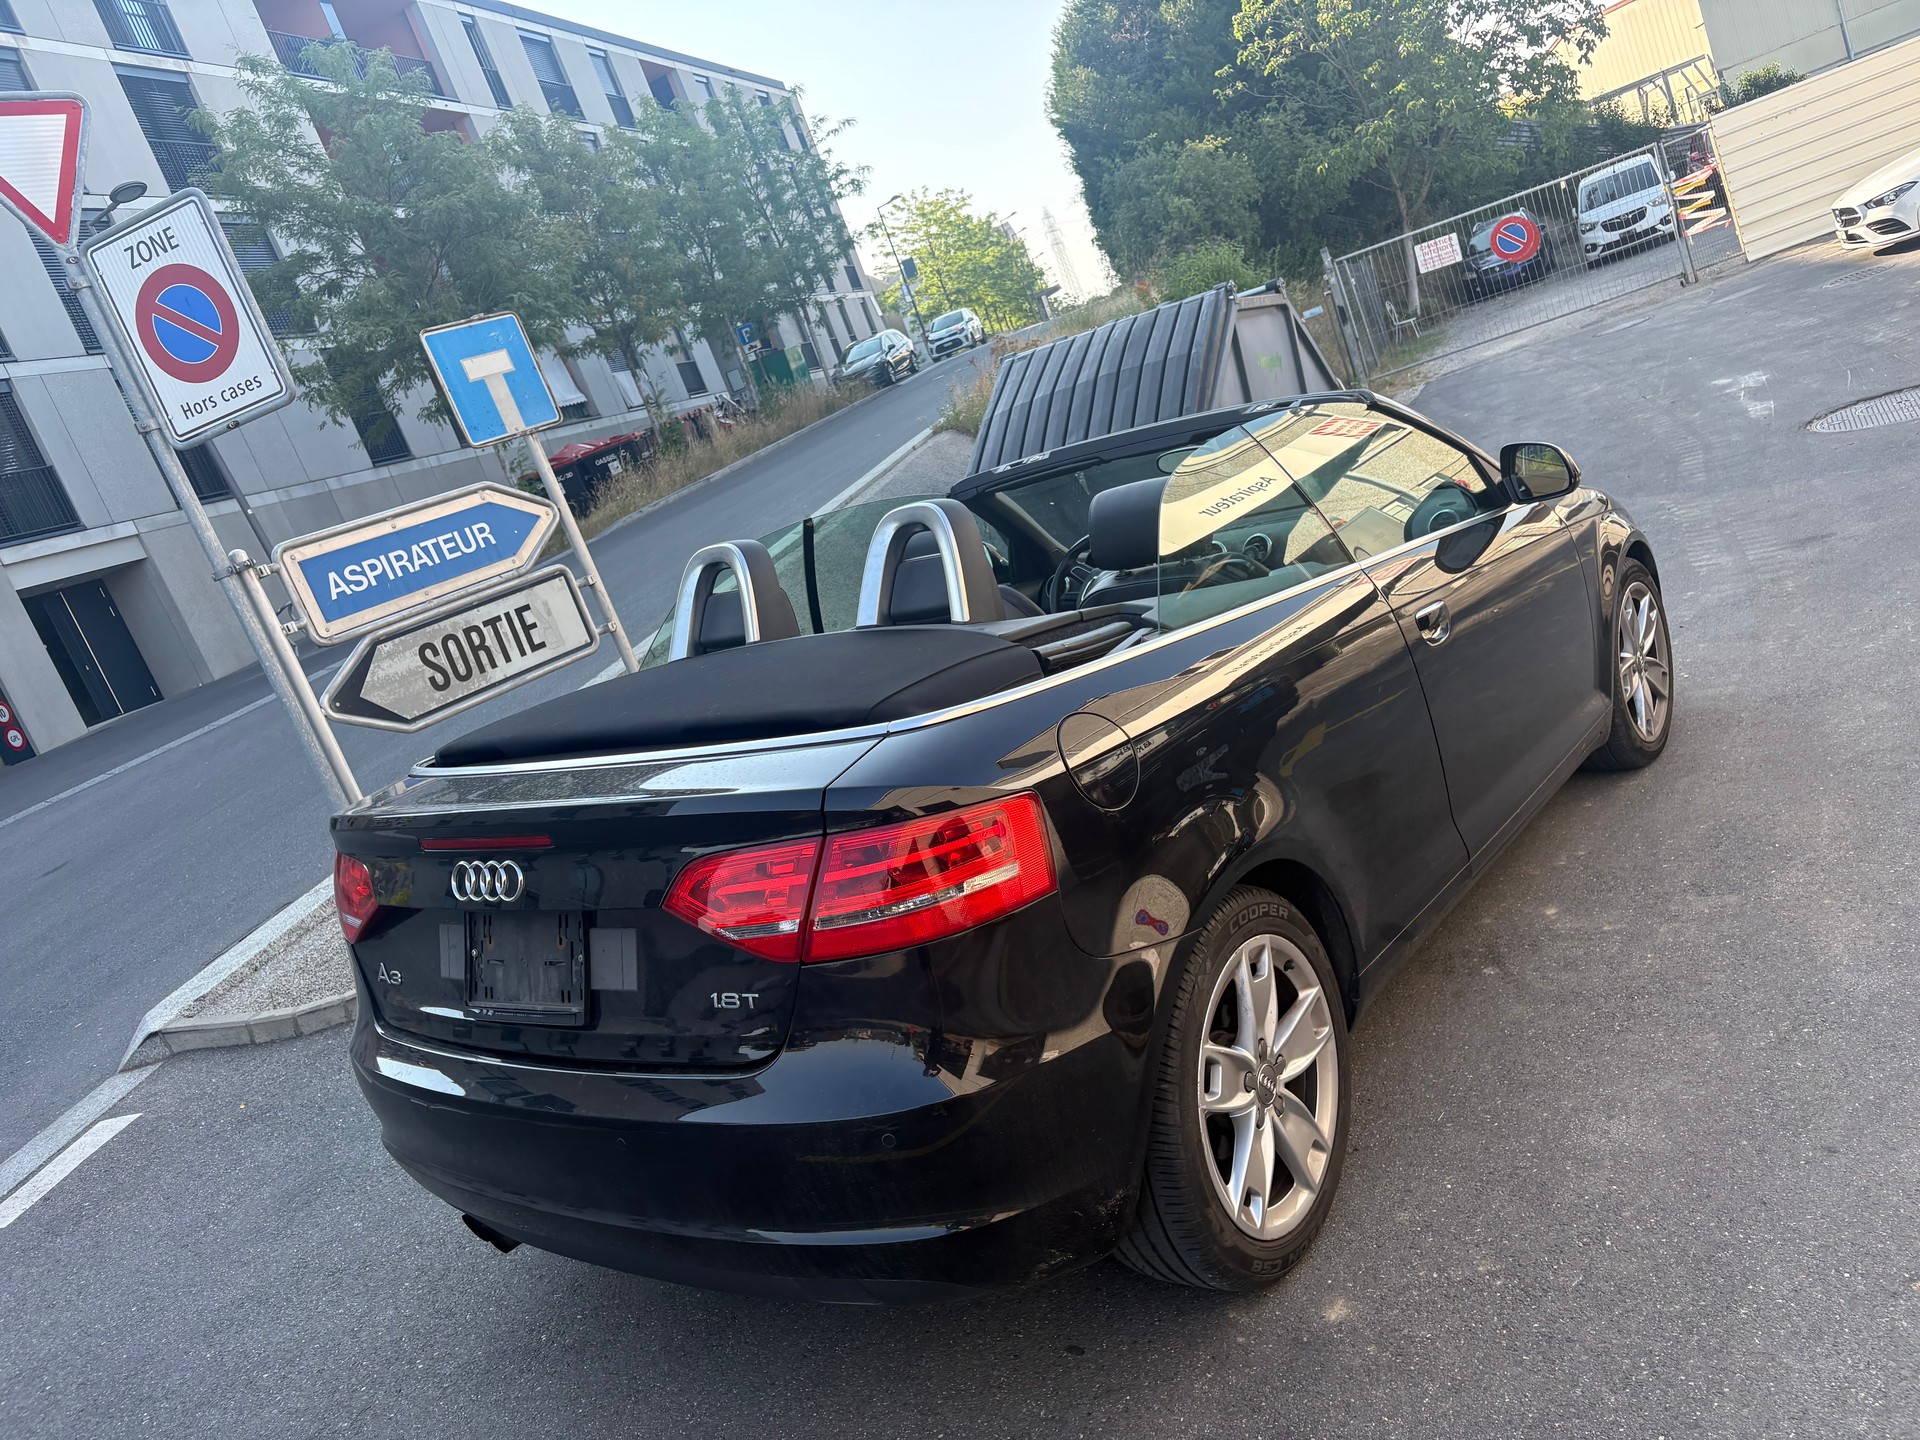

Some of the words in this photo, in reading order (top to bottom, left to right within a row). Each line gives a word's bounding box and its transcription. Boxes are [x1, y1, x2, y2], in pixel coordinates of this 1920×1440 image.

[123, 226, 180, 270] ZONE
[180, 394, 218, 420] Hors
[220, 375, 263, 403] cases
[327, 522, 497, 600] ASPIRATEUR
[418, 603, 547, 692] SORTIE
[10, 734, 20, 743] GPL
[1229, 903, 1289, 935] COOPER
[378, 962, 402, 985] A3
